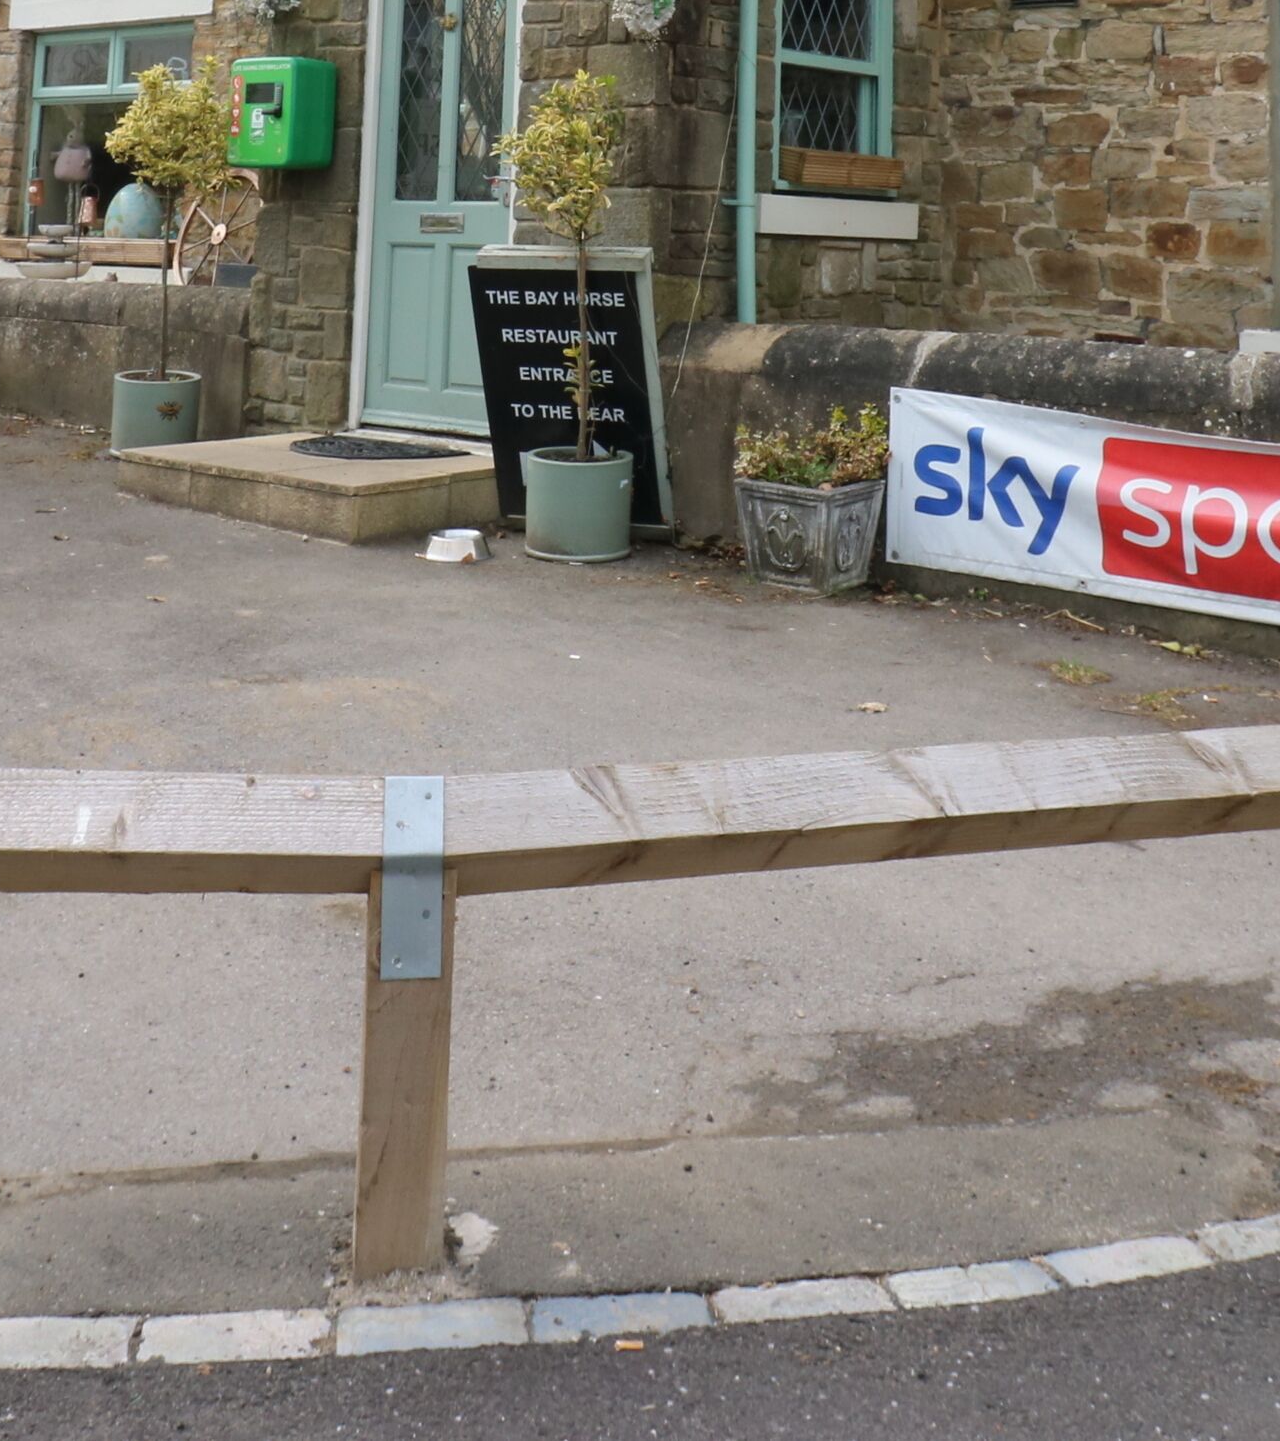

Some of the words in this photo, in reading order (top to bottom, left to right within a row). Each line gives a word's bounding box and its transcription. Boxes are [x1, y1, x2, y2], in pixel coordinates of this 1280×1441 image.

[485, 290, 520, 305] THE
[524, 290, 559, 306] BAY
[563, 291, 626, 308] HORSE
[501, 328, 618, 346] RESTAURANT
[519, 366, 614, 384] ENTRACE
[510, 403, 535, 418] TO
[538, 404, 573, 420] THE
[914, 427, 1081, 556] sky
